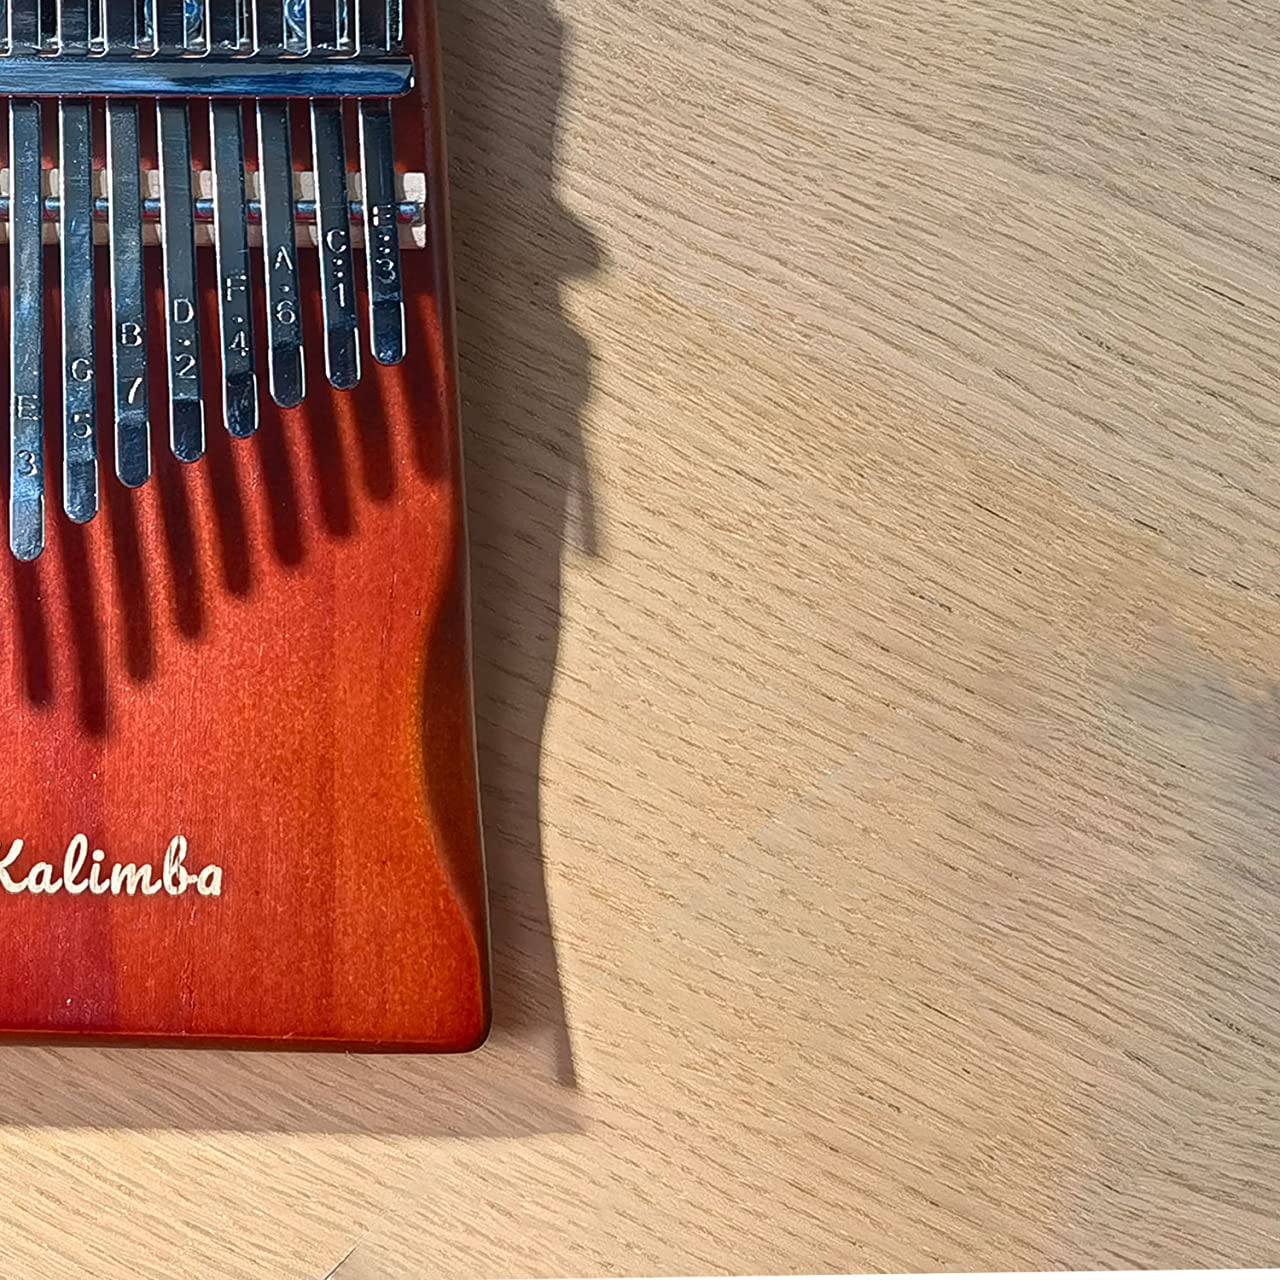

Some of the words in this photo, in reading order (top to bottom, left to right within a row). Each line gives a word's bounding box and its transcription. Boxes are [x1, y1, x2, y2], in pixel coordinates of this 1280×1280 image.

[326, 228, 347, 254] C
[274, 245, 294, 271] A
[375, 257, 396, 284] 3
[173, 298, 195, 324] D
[276, 299, 296, 324] 6
[120, 321, 143, 347] B
[228, 329, 250, 357] 4
[71, 358, 94, 382] G
[175, 353, 197, 380] 2
[121, 377, 143, 404] 7
[73, 413, 93, 439] 5
[17, 449, 37, 477] 3
